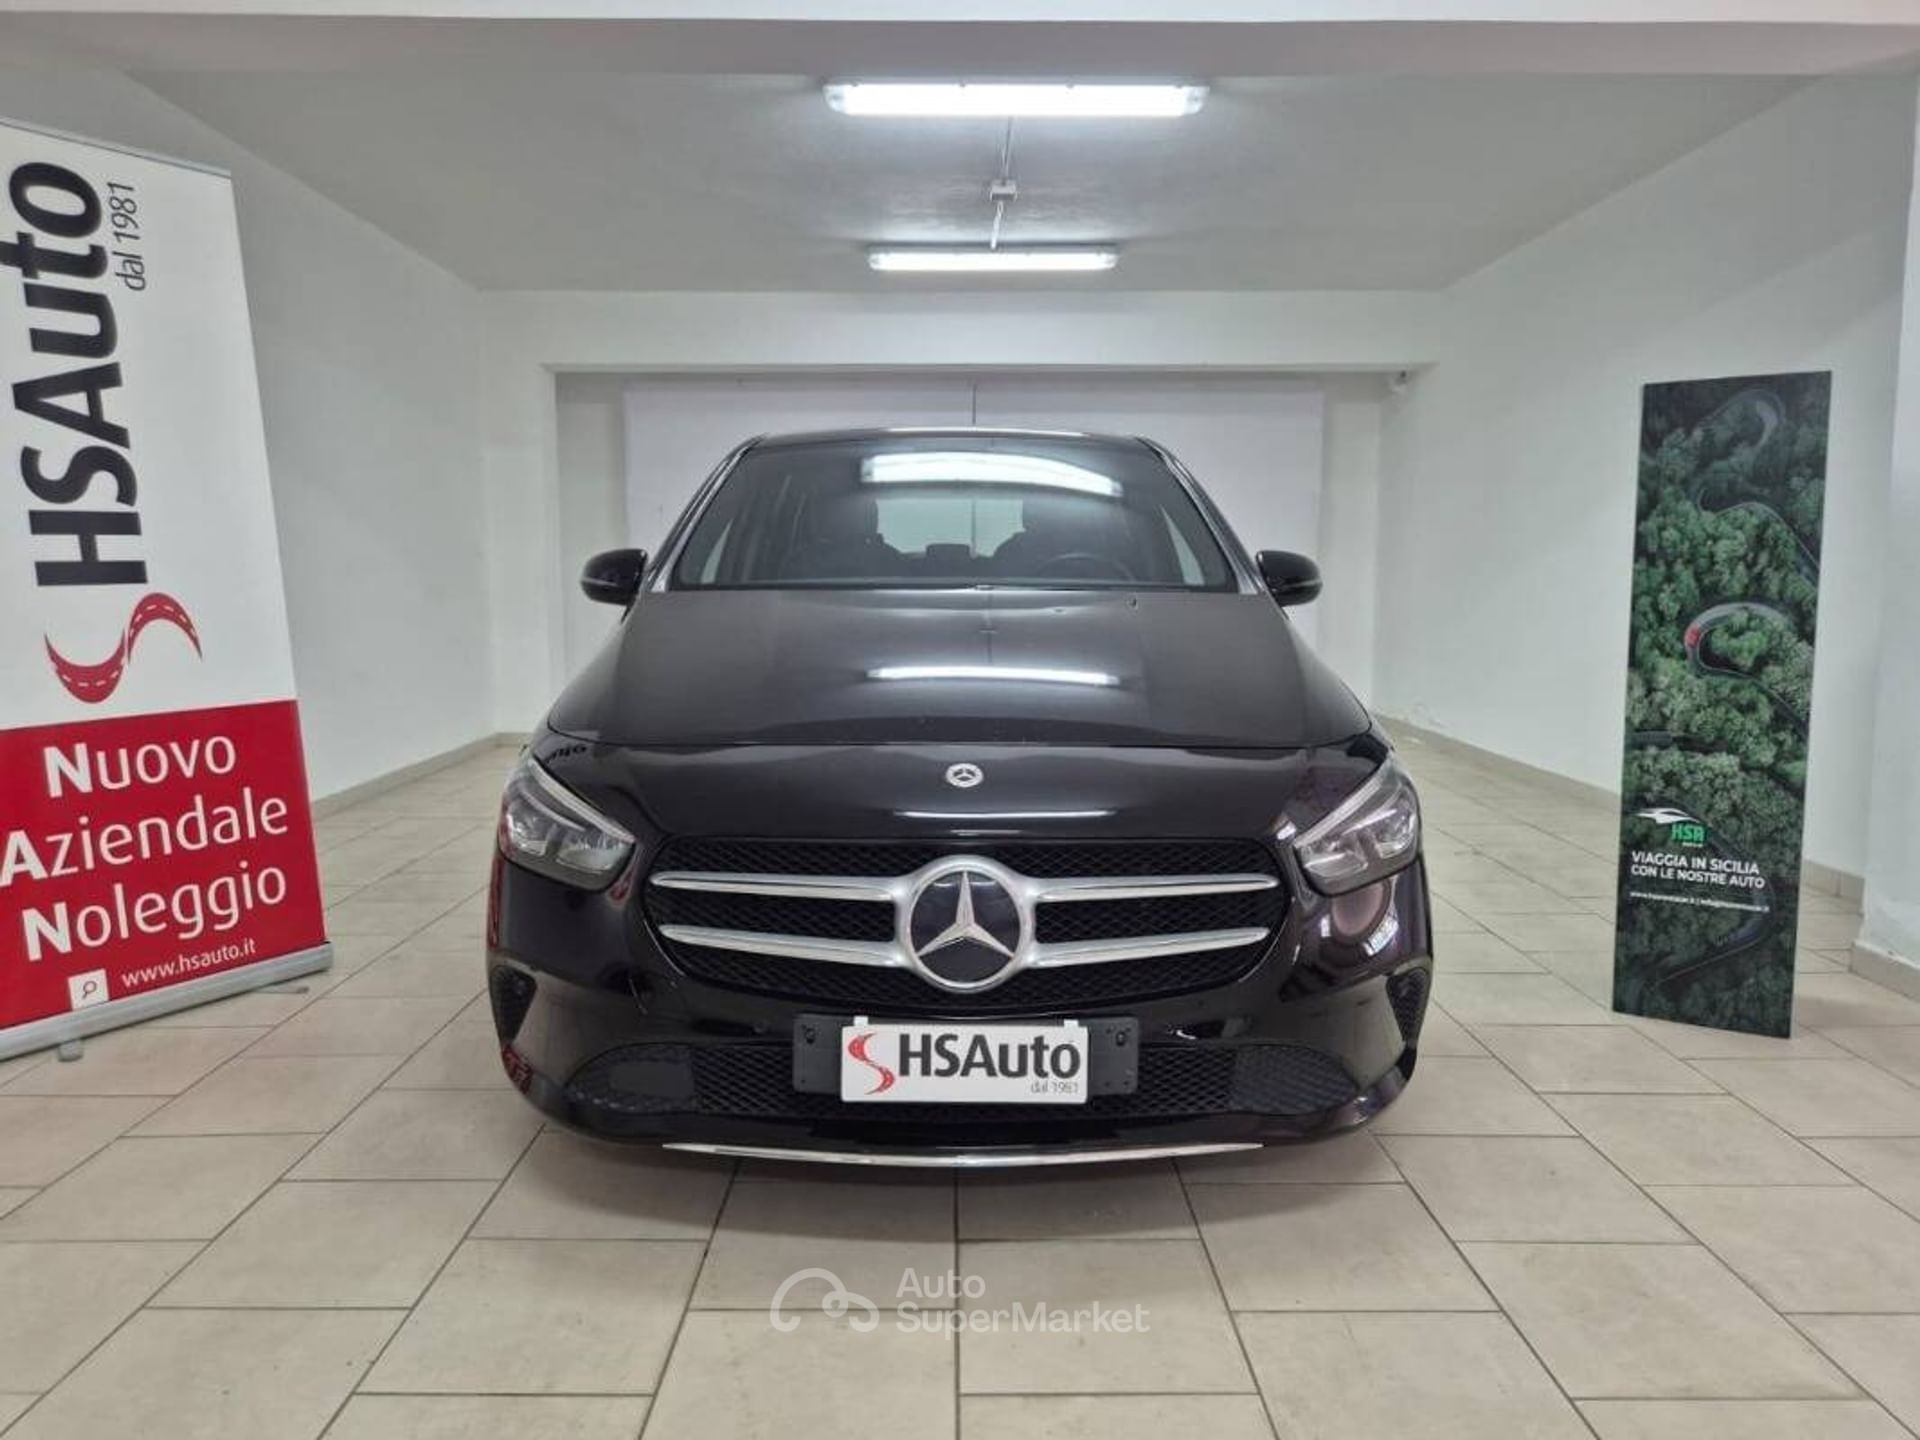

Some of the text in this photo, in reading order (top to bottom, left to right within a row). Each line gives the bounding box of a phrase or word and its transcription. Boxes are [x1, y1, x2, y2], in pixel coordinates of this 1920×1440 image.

[106, 182, 146, 291] dal 1981
[0, 162, 147, 586] HSAuto
[43, 736, 236, 798] Nuovo
[0, 787, 288, 888] Aziendale
[1632, 851, 1760, 875] VIAGGIA IN SICILIA
[1631, 864, 1765, 889] CON LE NOSTRE AUTO
[22, 860, 286, 962] Noleggio
[121, 938, 257, 988] www.hsauto.it
[899, 1032, 1081, 1079] HSAuto
